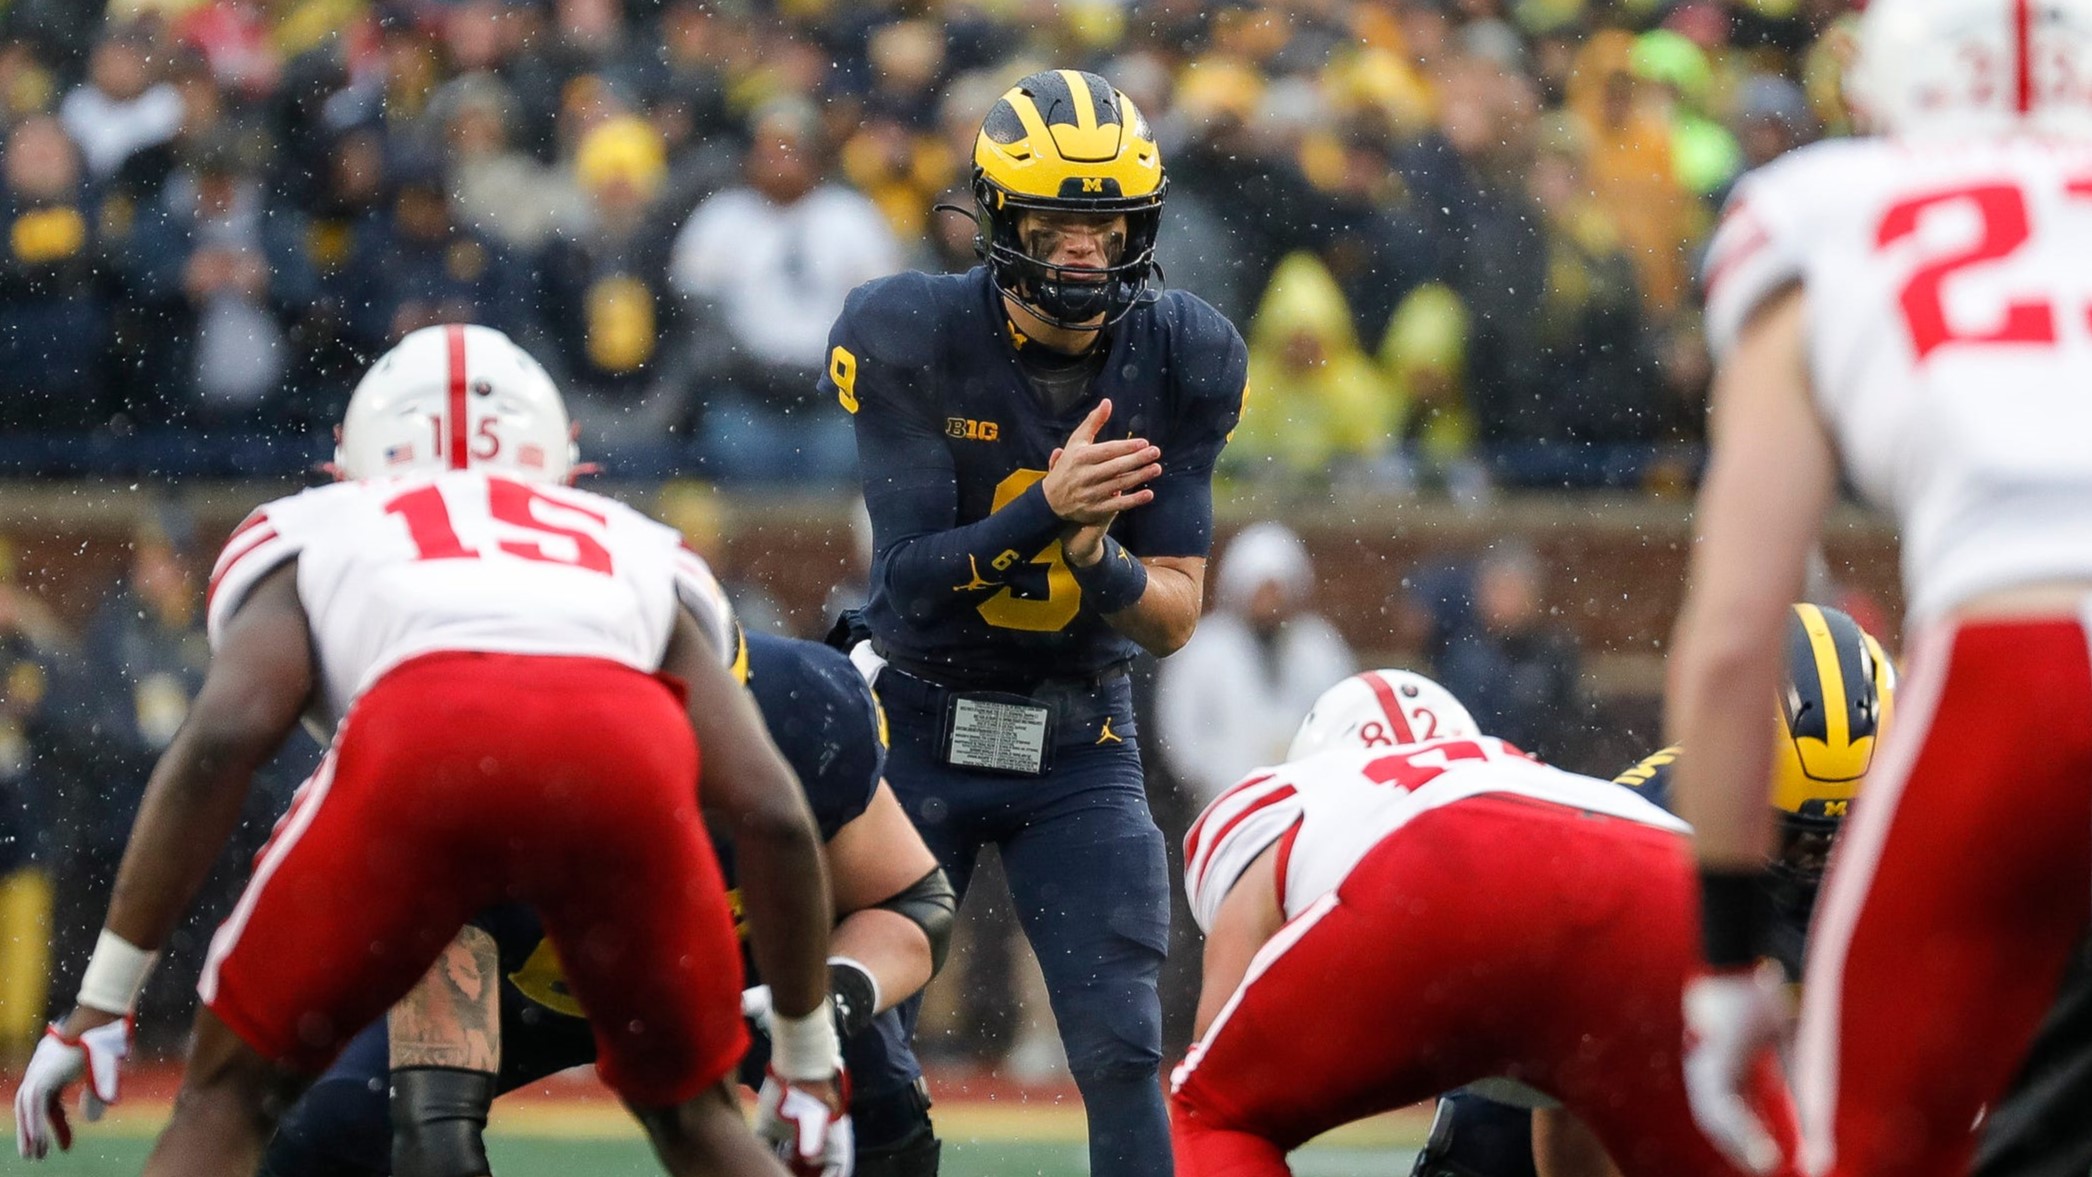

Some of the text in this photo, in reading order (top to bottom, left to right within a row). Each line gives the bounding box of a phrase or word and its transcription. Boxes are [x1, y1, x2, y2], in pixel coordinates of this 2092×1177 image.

[1082, 178, 1102, 192] M
[830, 345, 859, 414] 9
[384, 475, 613, 576] 15
[1824, 801, 1848, 817] M
